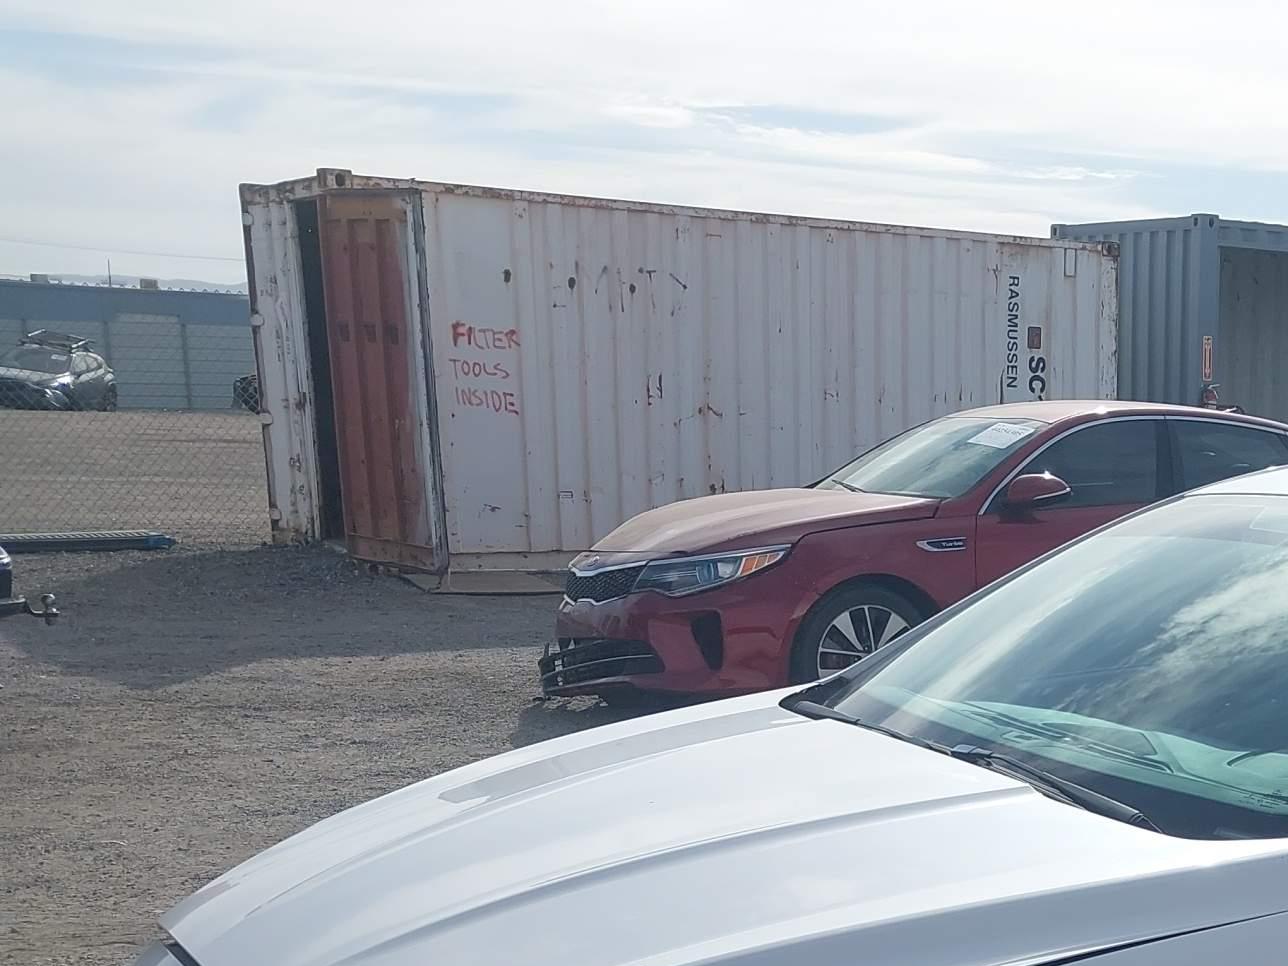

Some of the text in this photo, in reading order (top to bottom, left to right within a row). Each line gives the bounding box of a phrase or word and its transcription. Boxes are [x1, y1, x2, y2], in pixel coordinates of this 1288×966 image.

[452, 321, 520, 350] FILTER
[1006, 275, 1020, 388] RASMUSSEN
[448, 359, 510, 380] TOOLS
[1028, 356, 1046, 400] SC
[455, 387, 519, 415] INSIDE
